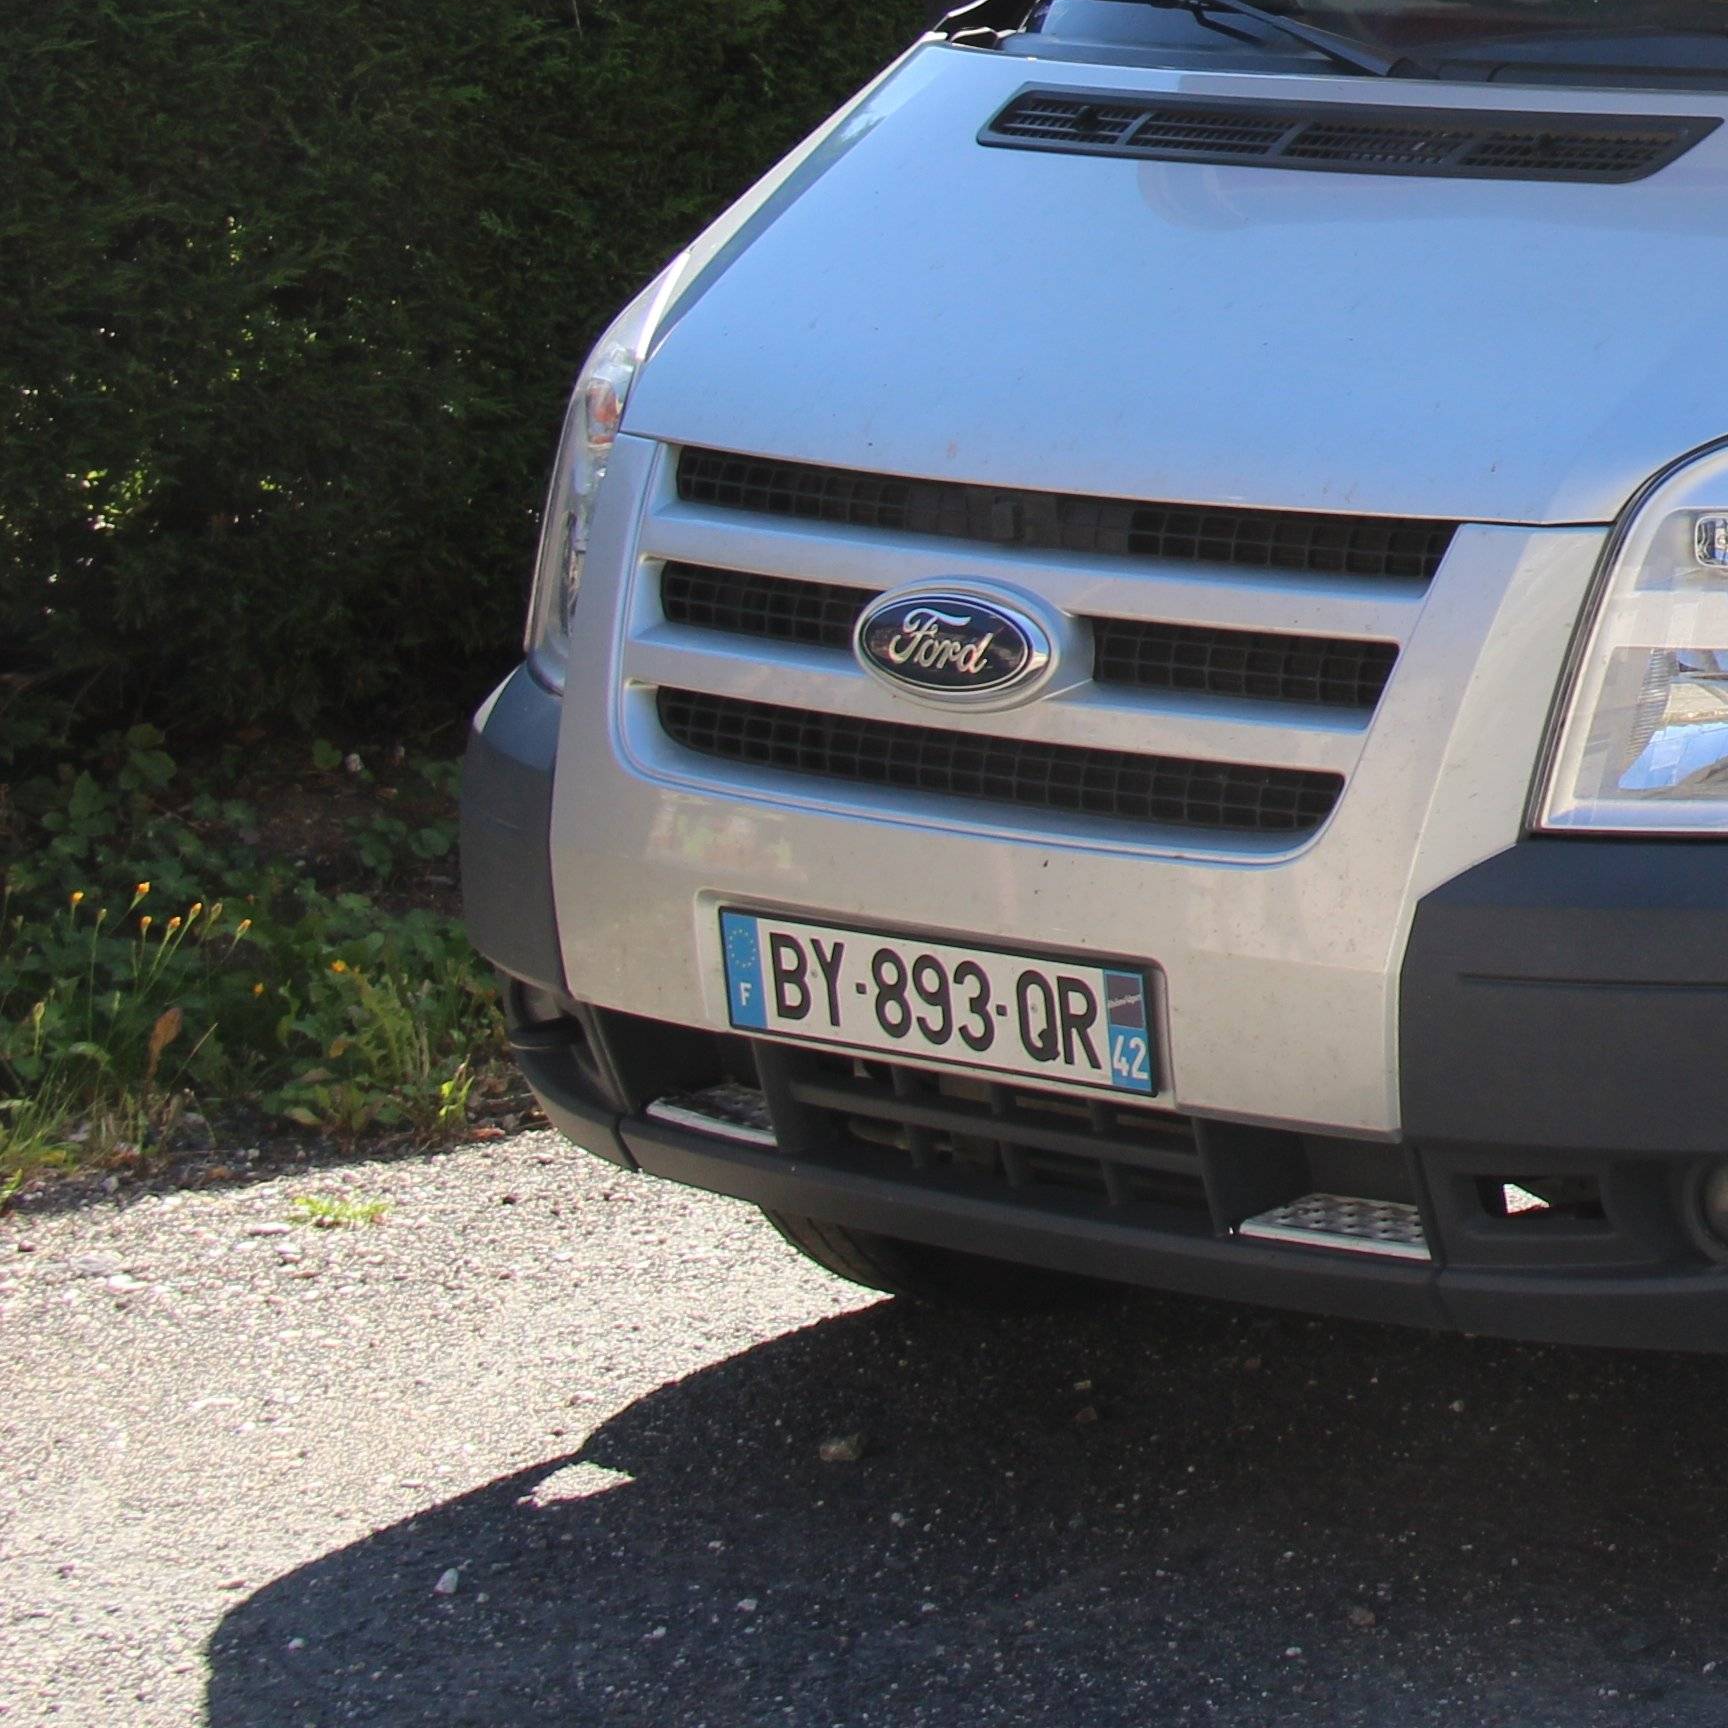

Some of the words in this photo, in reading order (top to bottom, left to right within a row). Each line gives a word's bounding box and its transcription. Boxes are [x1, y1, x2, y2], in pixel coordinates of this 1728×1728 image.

[888, 607, 994, 673] Ford
[740, 981, 752, 1006] F
[1113, 1035, 1149, 1080] 42
